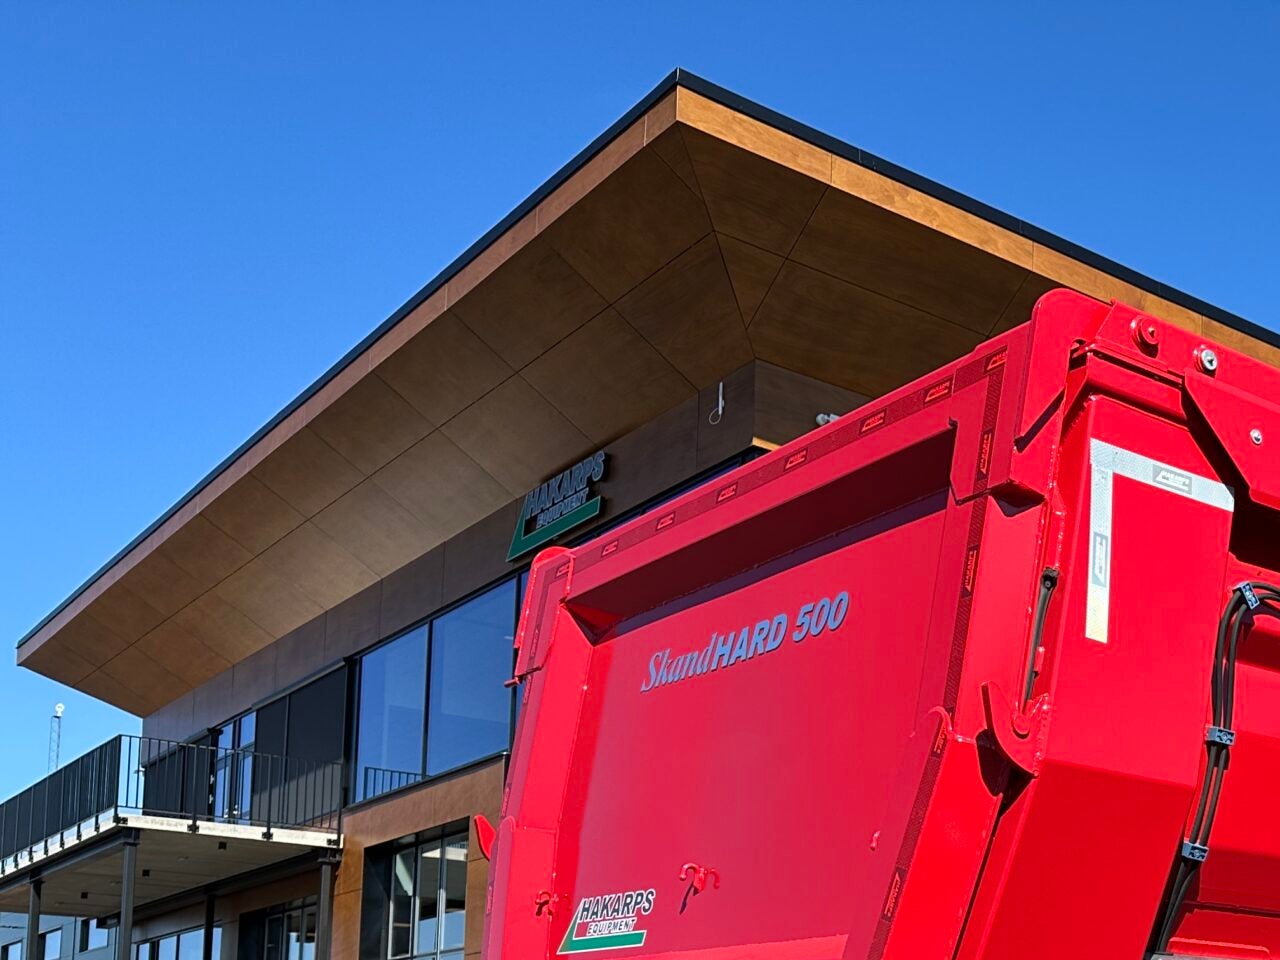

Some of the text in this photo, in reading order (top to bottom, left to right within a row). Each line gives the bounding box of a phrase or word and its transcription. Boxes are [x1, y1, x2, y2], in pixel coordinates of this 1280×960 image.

[524, 450, 605, 519] HAKARPS
[535, 488, 589, 529] EQUIPMENT
[640, 591, 849, 692] SkandHARD 500
[578, 889, 656, 922] HAKARPS
[586, 918, 637, 936] EQUIPMENT
